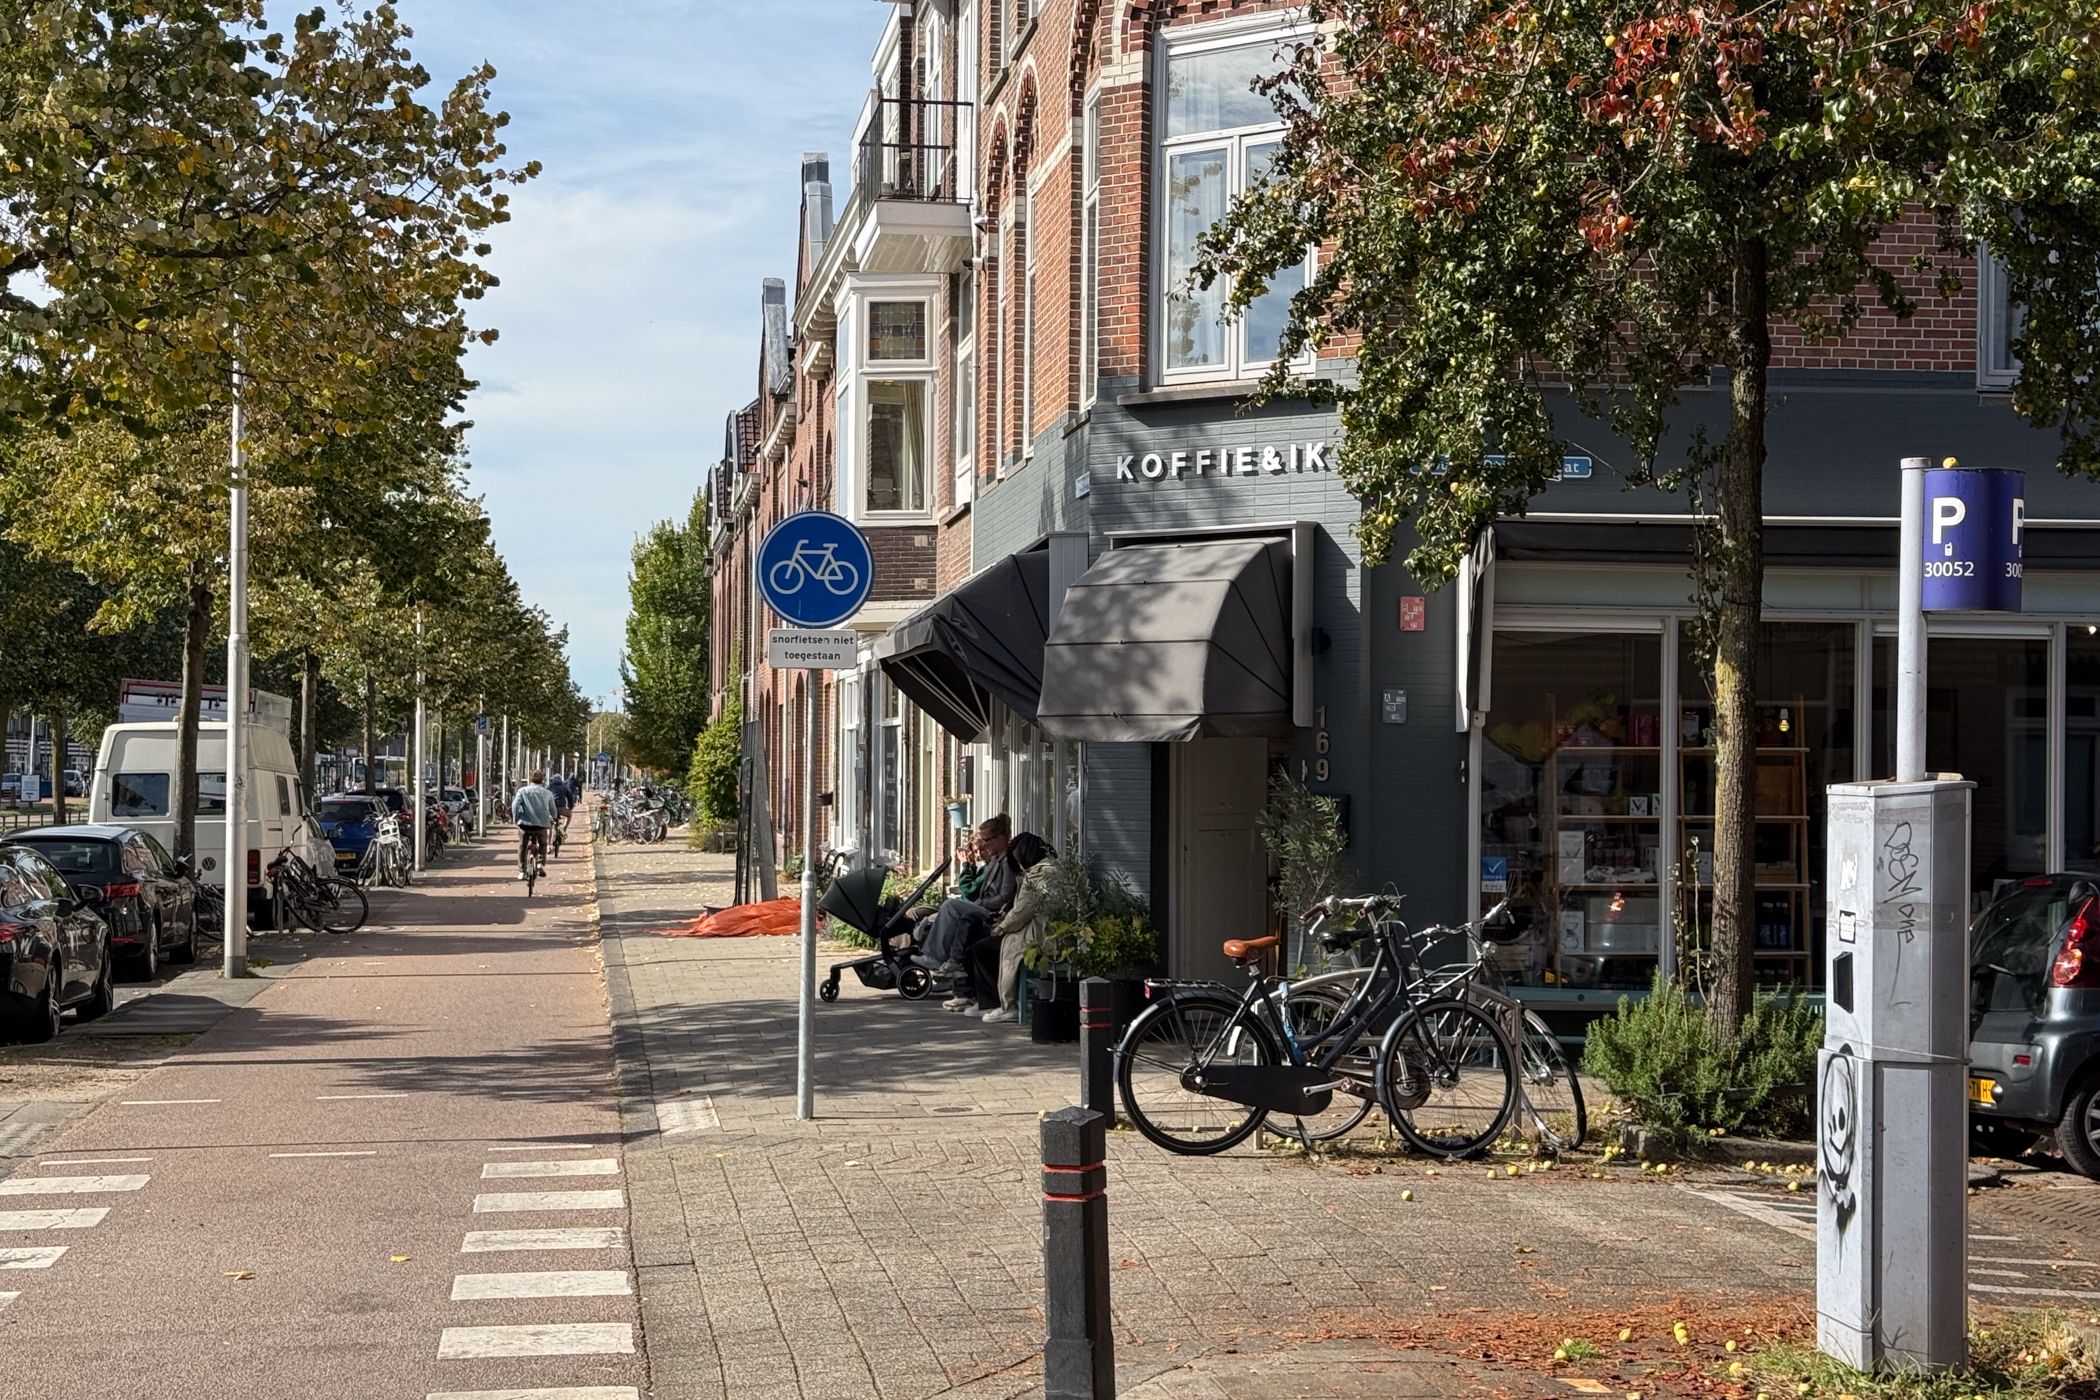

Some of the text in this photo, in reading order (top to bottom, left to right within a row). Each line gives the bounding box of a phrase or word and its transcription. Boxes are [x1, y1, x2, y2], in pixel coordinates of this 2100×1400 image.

[1116, 442, 1326, 480] KOFFIE&IK
[1932, 496, 1966, 545] P
[1924, 561, 1975, 577] 30052
[772, 635, 854, 645] snorfietsen niet
[784, 651, 841, 662] toegestaan
